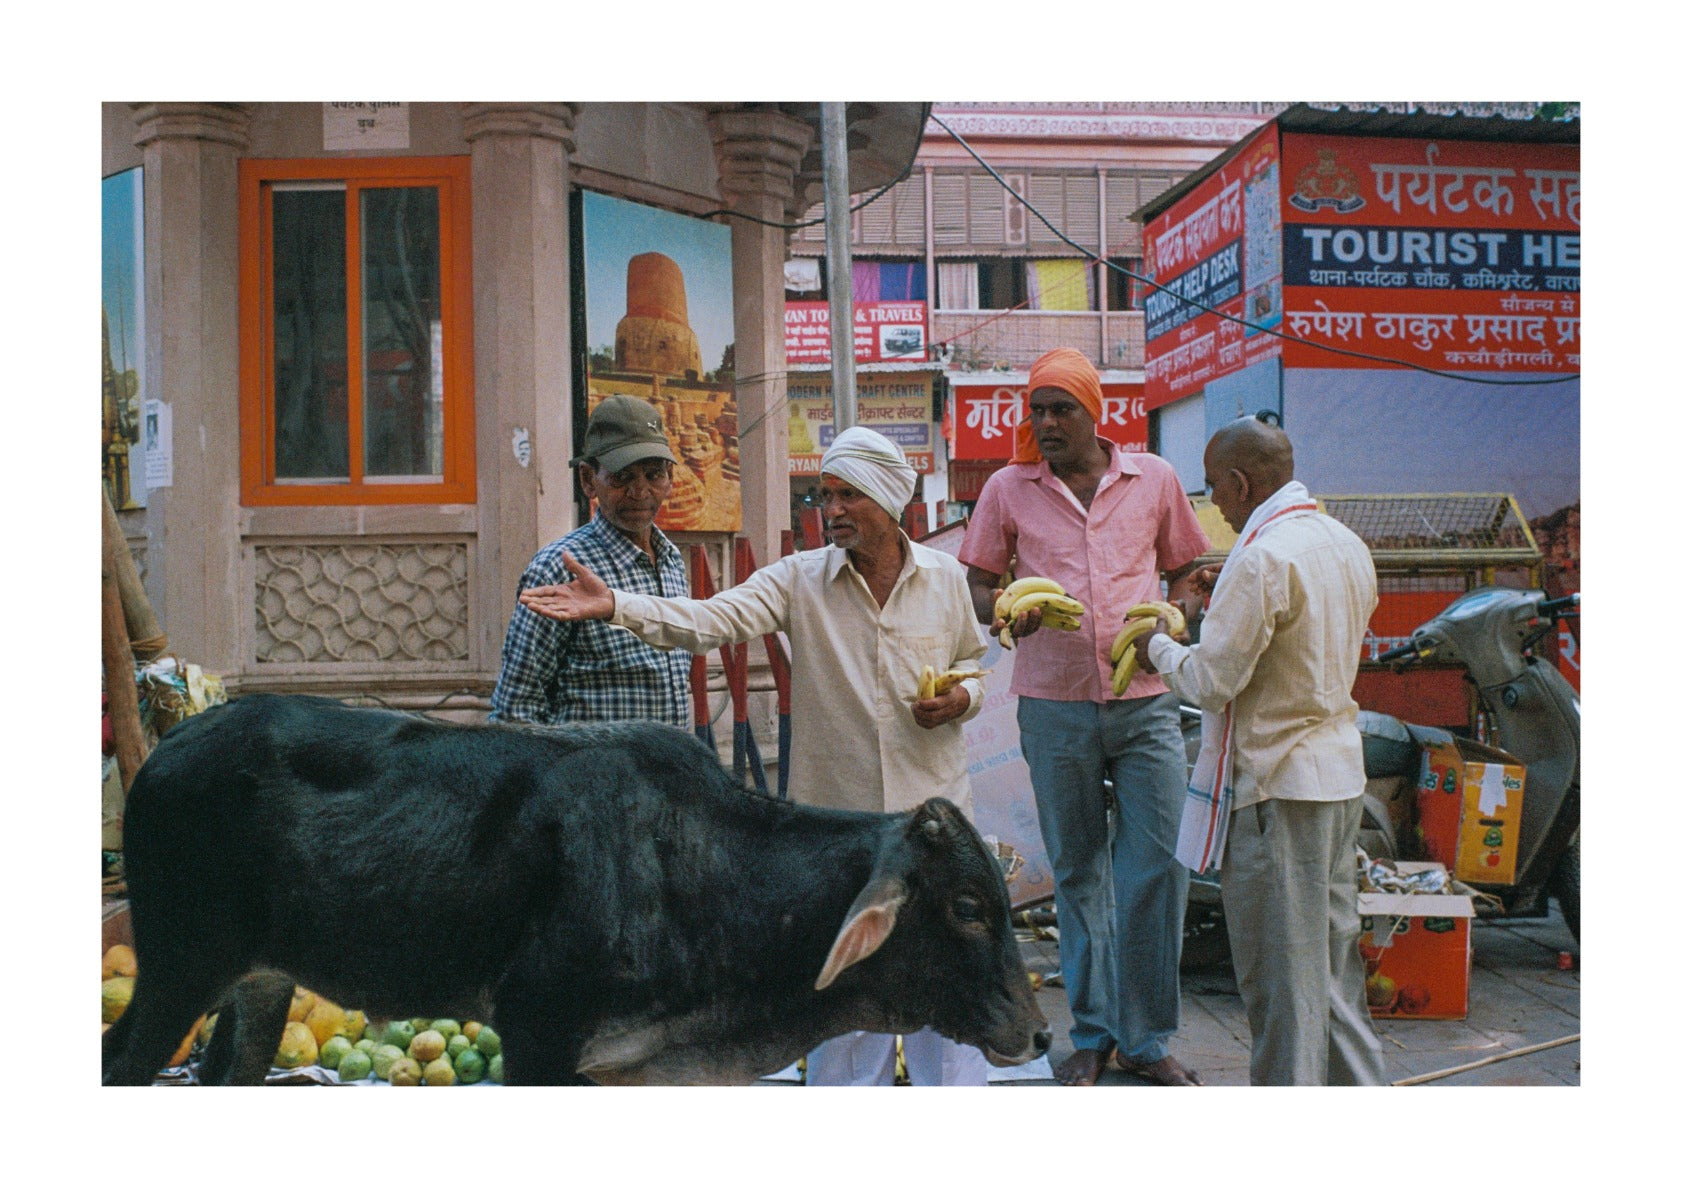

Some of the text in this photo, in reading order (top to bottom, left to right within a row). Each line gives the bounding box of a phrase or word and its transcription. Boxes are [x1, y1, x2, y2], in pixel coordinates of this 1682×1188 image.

[1370, 143, 1516, 214] पर्यटक
[1303, 228, 1580, 267] TOURIST HE
[1183, 262, 1208, 302] HELP
[1210, 243, 1238, 287] DESK
[1309, 265, 1408, 286] थाना-पर्यटक
[785, 309, 807, 323] YAN
[855, 310, 867, 322] &
[869, 308, 923, 321] TRAVELS
[1285, 299, 1580, 351] रुपेश ठाकुर प्रसाद प्र
[787, 385, 822, 398] ODERN
[888, 384, 925, 397] CENTRE
[788, 458, 820, 472] RYAN
